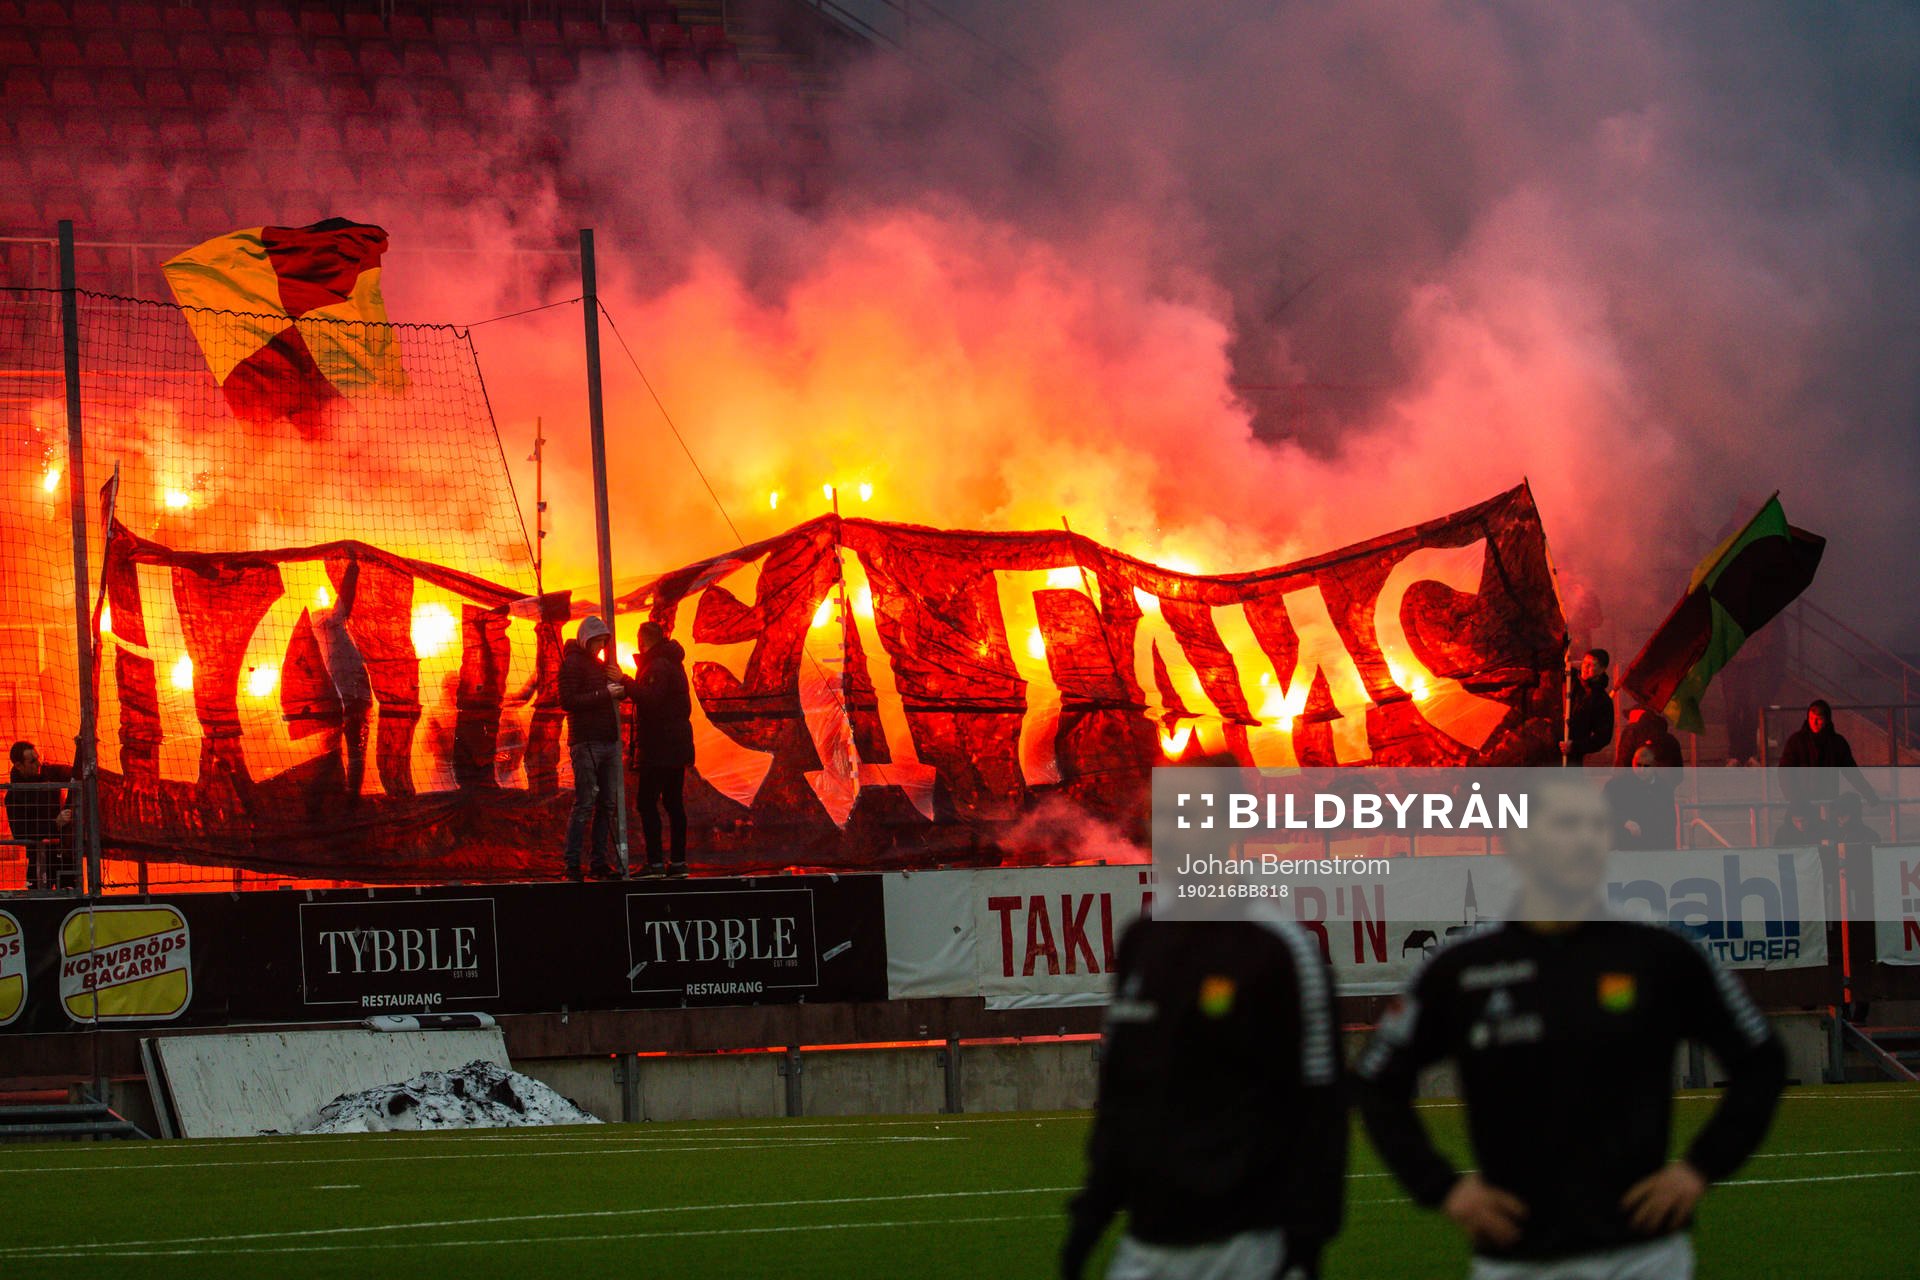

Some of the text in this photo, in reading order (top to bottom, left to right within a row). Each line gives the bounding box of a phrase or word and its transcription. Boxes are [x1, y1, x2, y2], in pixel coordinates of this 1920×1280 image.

[63, 933, 187, 978] KORVBRÖDS
[319, 927, 479, 974] TYBBLE
[645, 917, 798, 963] TYBBLE
[82, 955, 167, 989] BAGARN
[686, 981, 763, 995] RESTAURANG
[362, 993, 442, 1007] RESTAURANG
